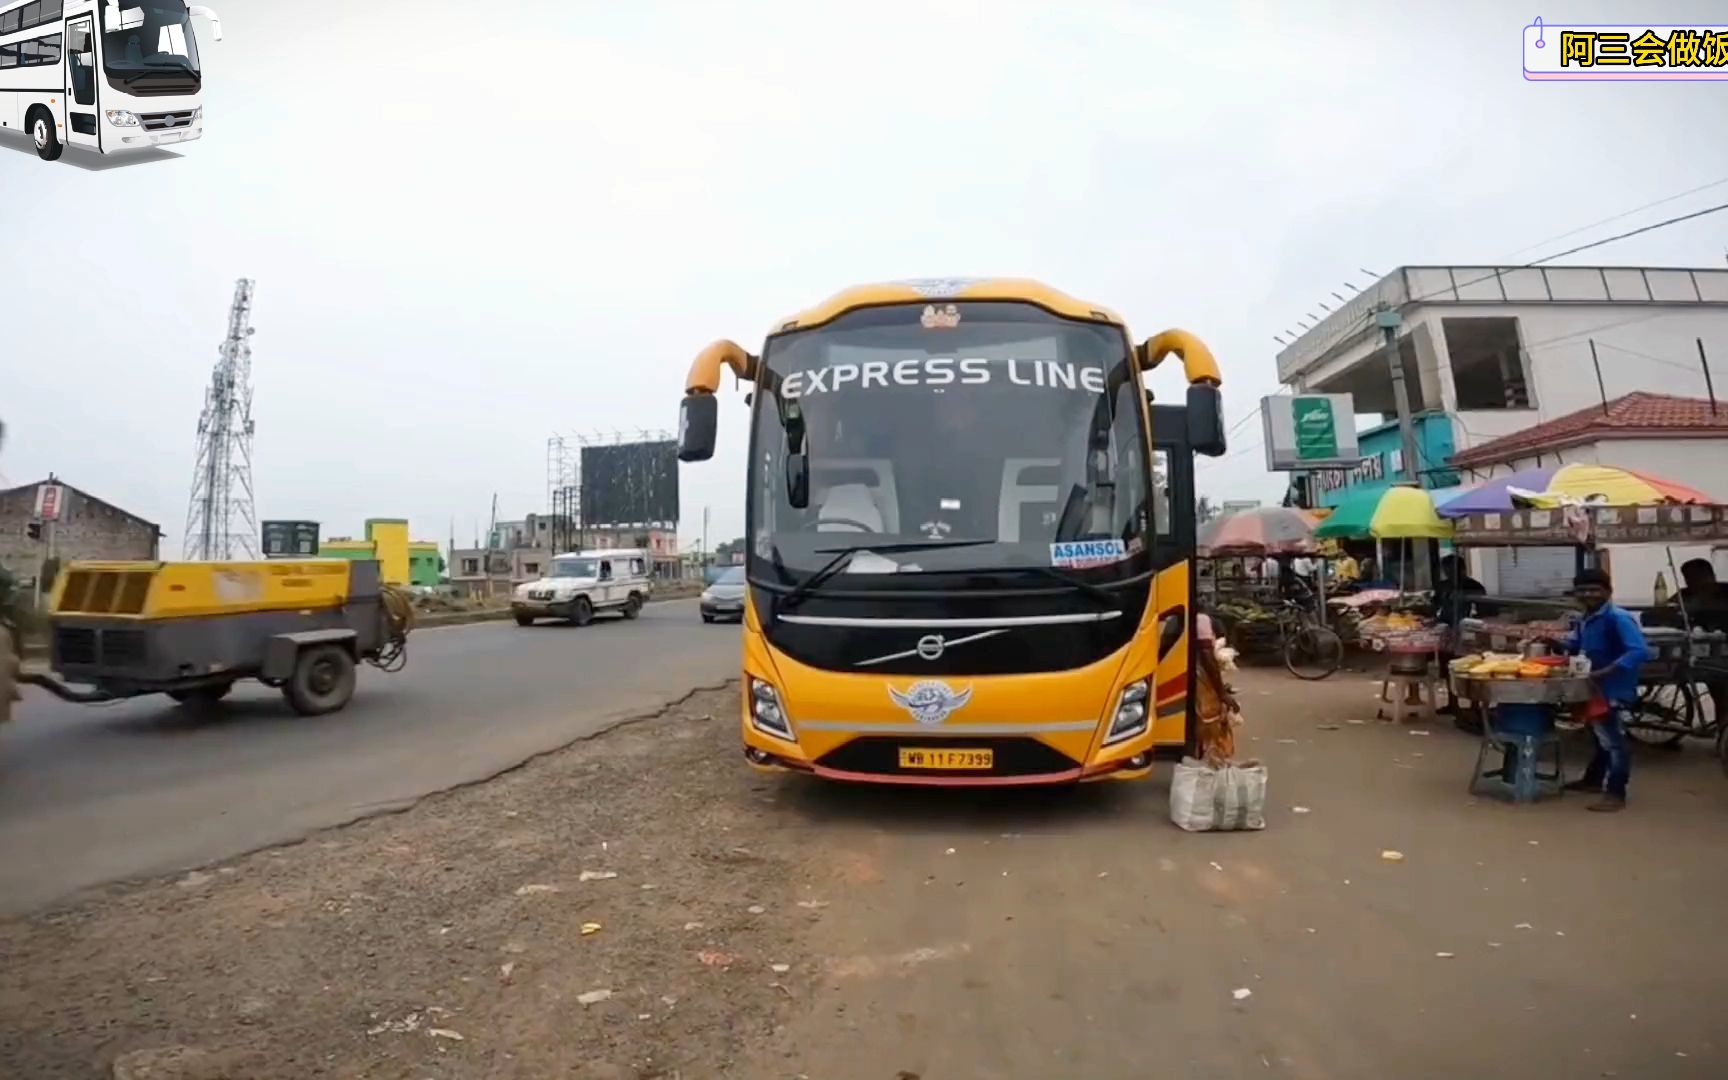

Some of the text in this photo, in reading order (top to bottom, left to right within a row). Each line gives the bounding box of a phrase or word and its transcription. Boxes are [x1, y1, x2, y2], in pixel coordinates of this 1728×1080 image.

[781, 358, 1105, 399] EXPRESS LINE
[1054, 542, 1123, 558] ASANSOL
